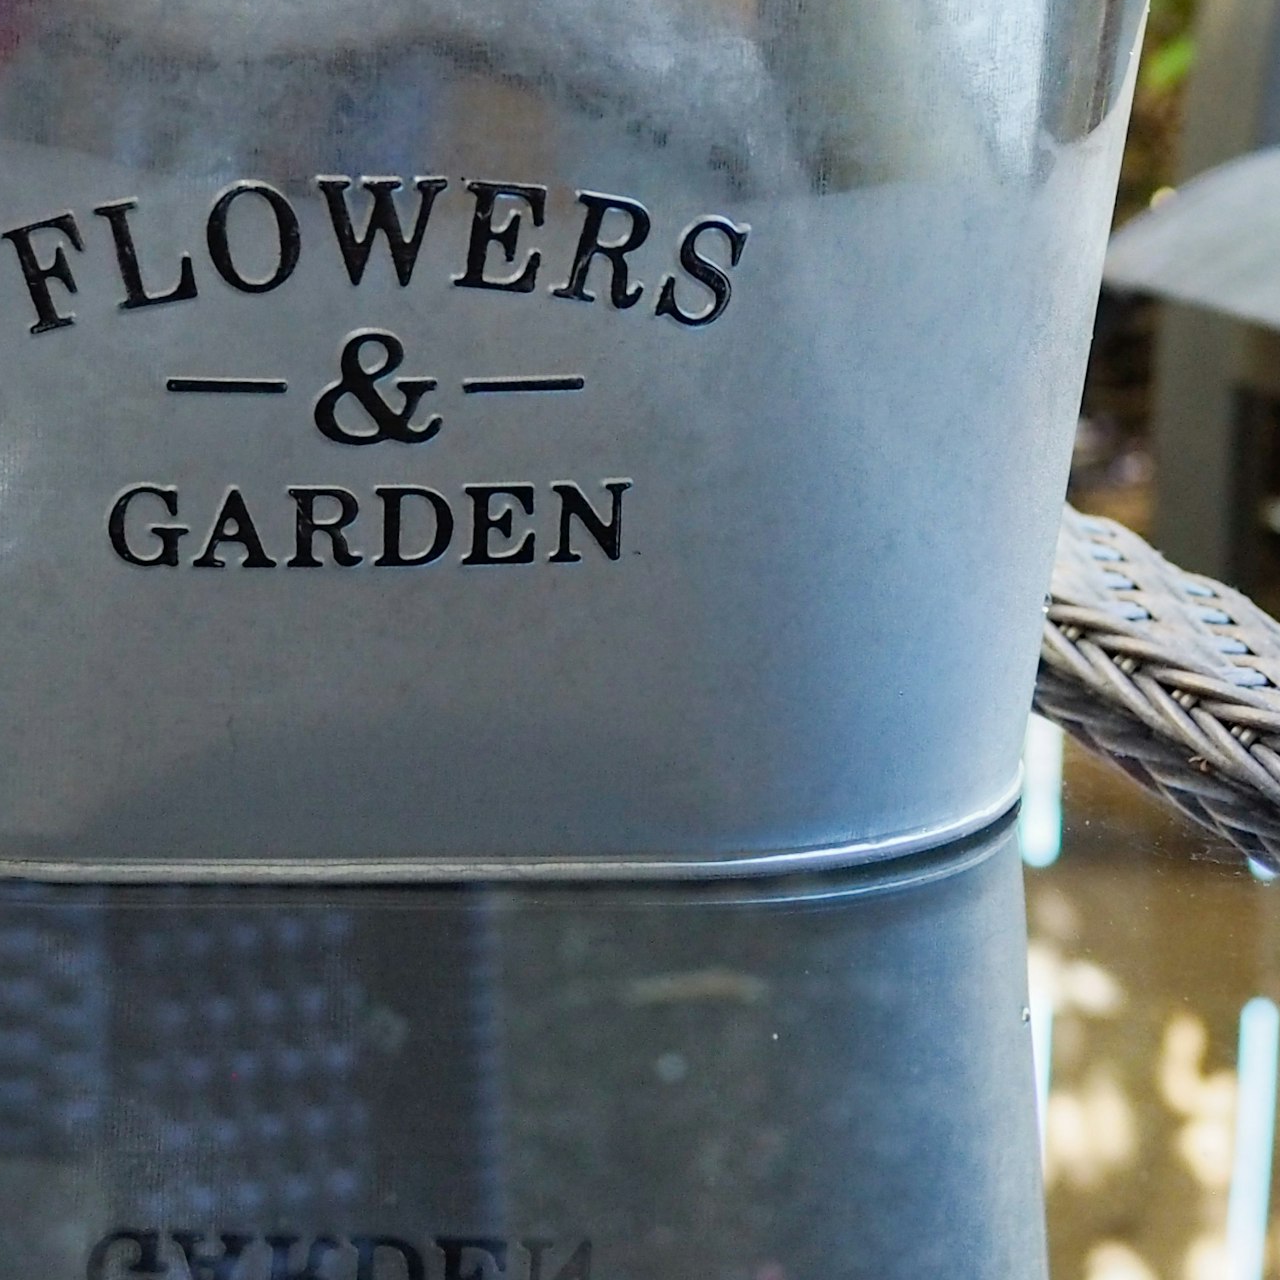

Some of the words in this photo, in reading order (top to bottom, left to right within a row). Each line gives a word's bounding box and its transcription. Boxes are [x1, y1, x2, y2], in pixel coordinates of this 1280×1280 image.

[2, 175, 751, 335] FLOWERS
[314, 328, 444, 446] &
[108, 478, 634, 569] GARDEN
